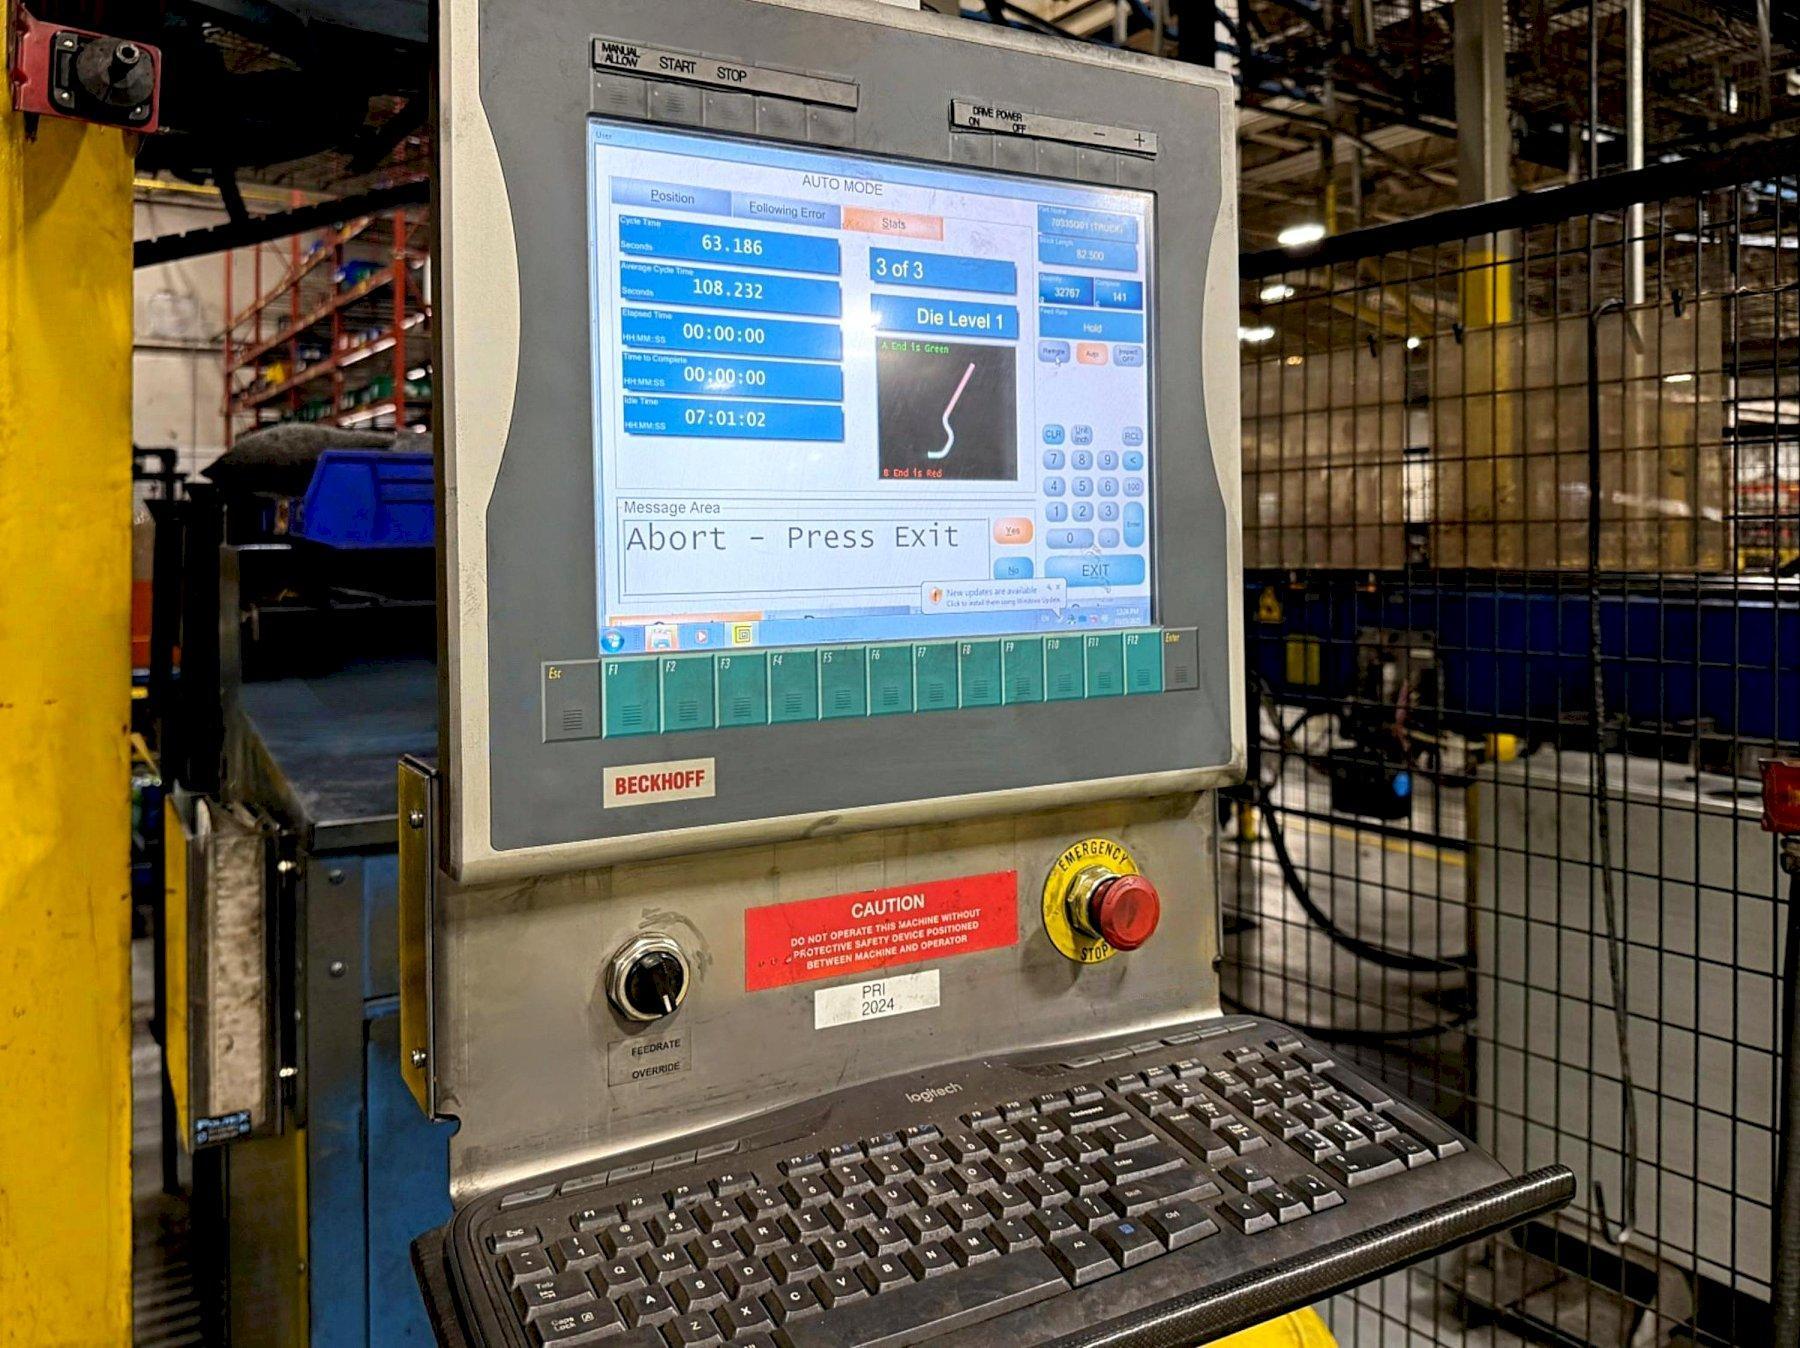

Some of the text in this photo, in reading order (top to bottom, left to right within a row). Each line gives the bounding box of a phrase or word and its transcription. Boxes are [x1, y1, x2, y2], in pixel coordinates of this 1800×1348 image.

[602, 42, 640, 58] MANUAL
[605, 53, 638, 67] ALLOW
[659, 56, 697, 74] START
[717, 66, 747, 83] STOP
[972, 106, 1022, 122] DRIVE POWER
[968, 117, 980, 127] ON
[1012, 123, 1026, 134] OFF
[802, 174, 883, 196] AUTO MODE
[650, 189, 695, 204] Position
[749, 201, 826, 220] Following Error
[620, 216, 662, 228] Cycle Time
[882, 218, 906, 231] Stats
[620, 240, 653, 251] Seconds
[701, 234, 763, 256] 63.186
[621, 262, 695, 277] Average Cycle Time
[876, 258, 924, 279] 3 of 3
[621, 286, 654, 297] Seconds
[692, 278, 763, 300] 108.232
[622, 308, 673, 321] Elapsed Time
[917, 308, 1004, 330] Die Level 1
[683, 323, 765, 344] 00:00:00
[1083, 323, 1103, 334] Hold
[892, 342, 907, 351] End
[912, 343, 920, 352] is
[925, 344, 949, 354] Green
[624, 353, 641, 361] Time
[652, 355, 688, 365] Complete
[684, 366, 766, 386] 00:00:00
[624, 397, 659, 406] Idle Time
[685, 409, 766, 428] 07:01:02
[1124, 432, 1140, 441] RCL
[1051, 453, 1057, 464] 7
[1079, 455, 1086, 465] 8
[1104, 454, 1111, 465] 9
[894, 468, 909, 477] End
[914, 468, 922, 478] is
[926, 469, 942, 478] Red
[1051, 481, 1057, 491] 4
[1080, 480, 1086, 491] 5
[1105, 481, 1111, 492] 6
[624, 501, 721, 516] Message Area
[1054, 506, 1059, 517] 1
[1079, 506, 1086, 517] 2
[1105, 506, 1112, 517] 3
[626, 522, 727, 551] Abort
[788, 526, 874, 549] Press
[895, 522, 959, 548] Exit
[1005, 526, 1020, 536] Yes
[1066, 532, 1074, 544] 0
[1008, 566, 1019, 576] No
[1082, 564, 1110, 578] EXIT
[965, 588, 993, 598] updates
[1088, 637, 1100, 647] F11
[1127, 635, 1139, 645] F12
[1165, 632, 1180, 644] Enter
[962, 644, 972, 654] F8
[1006, 642, 1014, 652] F9
[1048, 640, 1059, 650] F10
[823, 652, 832, 663] F5
[871, 650, 880, 660] F6
[917, 647, 926, 657] F7
[720, 658, 731, 670] F3
[772, 655, 782, 666] F4
[608, 664, 619, 675] F1
[666, 661, 677, 672] F2
[548, 667, 563, 680] Esc
[615, 769, 705, 797] BECKHOFF
[1058, 841, 1128, 872] EMERGENCY
[851, 893, 925, 919] CAUTION
[791, 909, 981, 948] DO NOT OPERATE THIS MACHINE WITHOUT
[793, 921, 979, 959] PROTECTIVE SAFETY DEVICE POSITIONED
[806, 935, 968, 970] BETWEEN MACHINE AND OPERATOR
[1081, 943, 1108, 961] STOP
[862, 983, 886, 999] PRI
[862, 998, 895, 1016] 2024
[631, 1038, 681, 1057] FEEDRATE
[632, 1061, 681, 1080] OVERRIDE
[905, 1082, 963, 1103] logitech
[1005, 1158, 1013, 1166] P
[967, 1167, 977, 1176] O
[888, 1190, 898, 1199] U
[1003, 1191, 1013, 1199] L
[846, 1203, 855, 1211] Y
[962, 1203, 973, 1211] K
[803, 1214, 812, 1223] T
[758, 1226, 768, 1236] R
[879, 1226, 891, 1235] H
[711, 1239, 722, 1249] E
[967, 1237, 980, 1246] M
[662, 1251, 675, 1261] W
[791, 1253, 800, 1262] F
[926, 1250, 937, 1259] N
[614, 1266, 626, 1275] Q
[743, 1266, 754, 1275] D
[882, 1264, 893, 1273] B
[836, 1277, 846, 1286] V
[646, 1295, 656, 1304] A
[790, 1292, 801, 1301] C
[740, 1306, 751, 1316] X
[690, 1321, 701, 1330] Z
